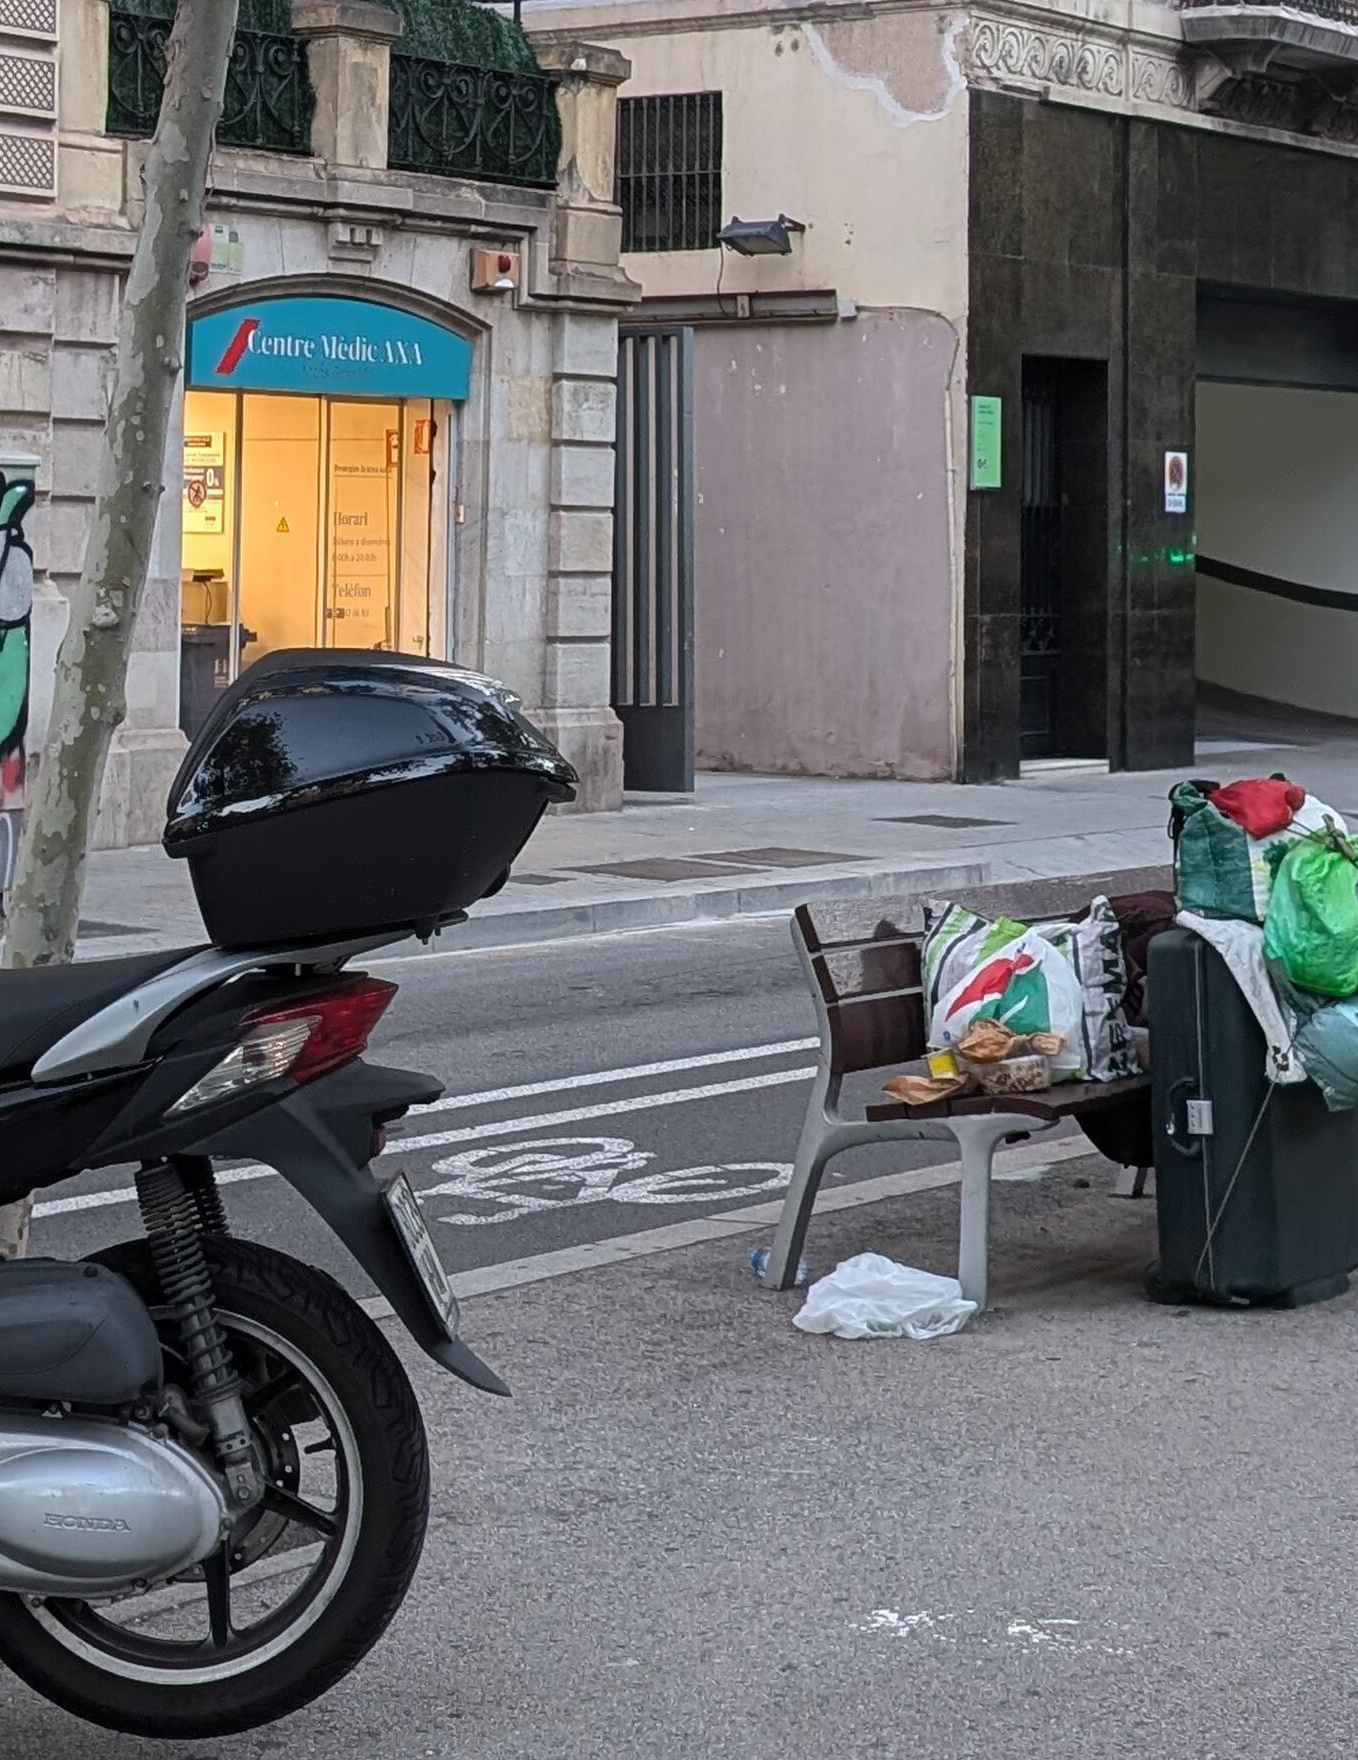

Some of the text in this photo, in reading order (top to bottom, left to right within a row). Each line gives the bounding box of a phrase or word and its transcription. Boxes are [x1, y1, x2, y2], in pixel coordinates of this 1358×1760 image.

[248, 329, 423, 365] Centre Mèdic AXA
[43, 1511, 132, 1532] HONDA
